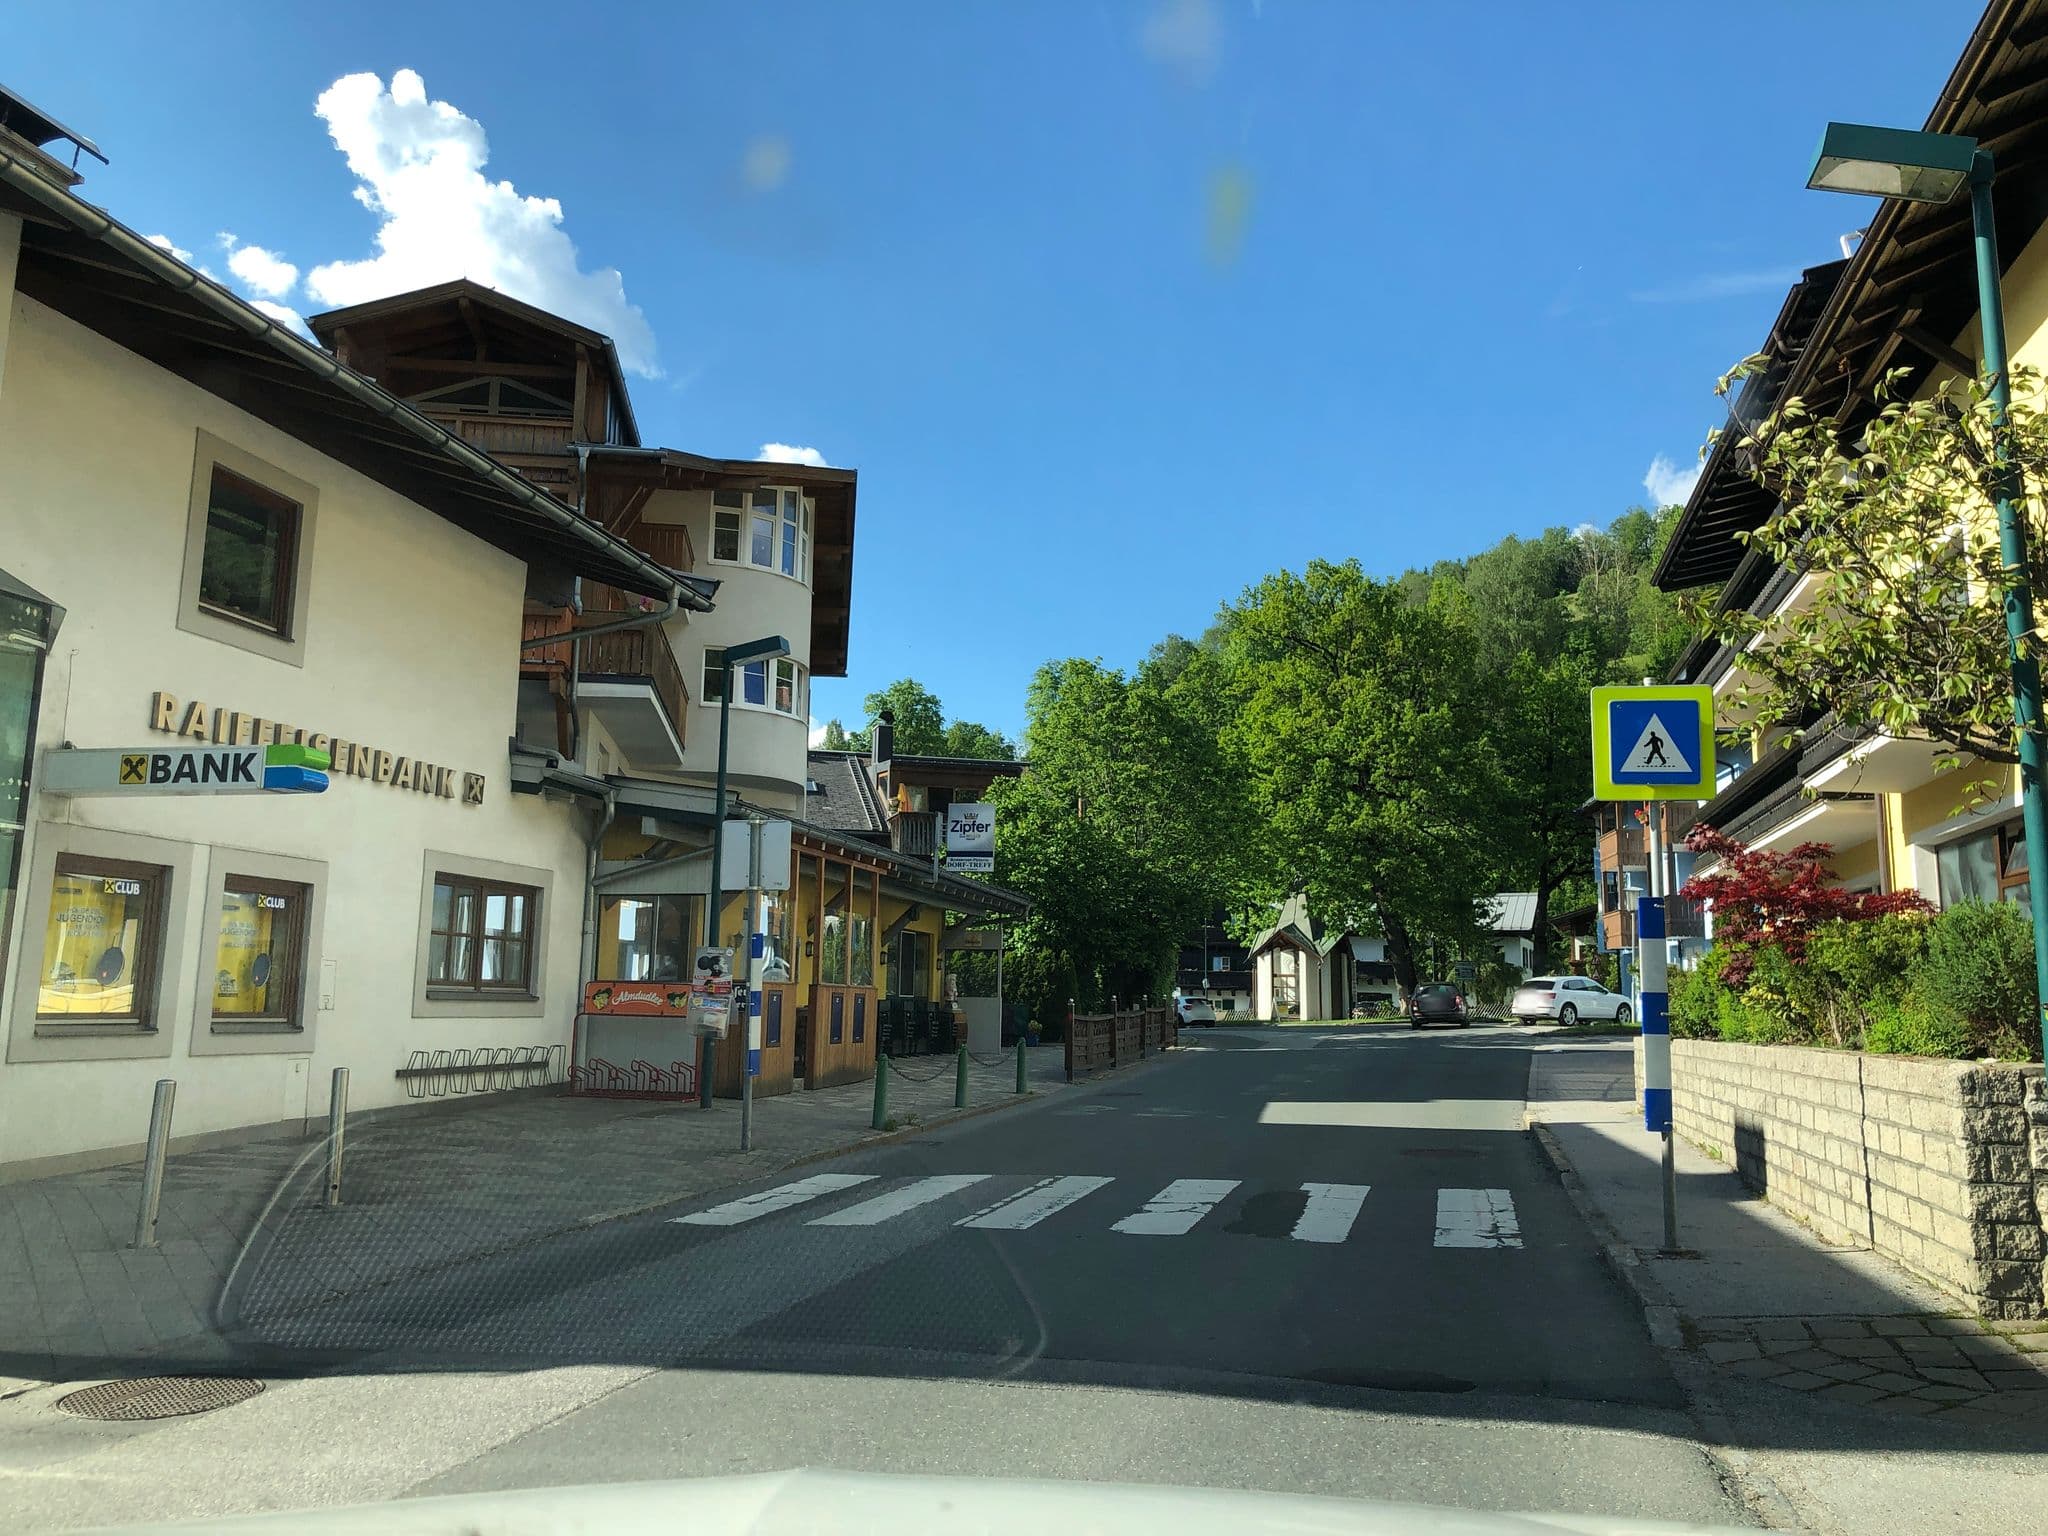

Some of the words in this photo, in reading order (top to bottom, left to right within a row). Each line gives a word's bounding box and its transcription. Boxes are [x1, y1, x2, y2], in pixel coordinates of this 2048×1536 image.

[150, 752, 258, 784] BANK
[950, 820, 991, 835] Zipfer
[115, 881, 140, 895] CLUB
[266, 896, 286, 909] CLUB
